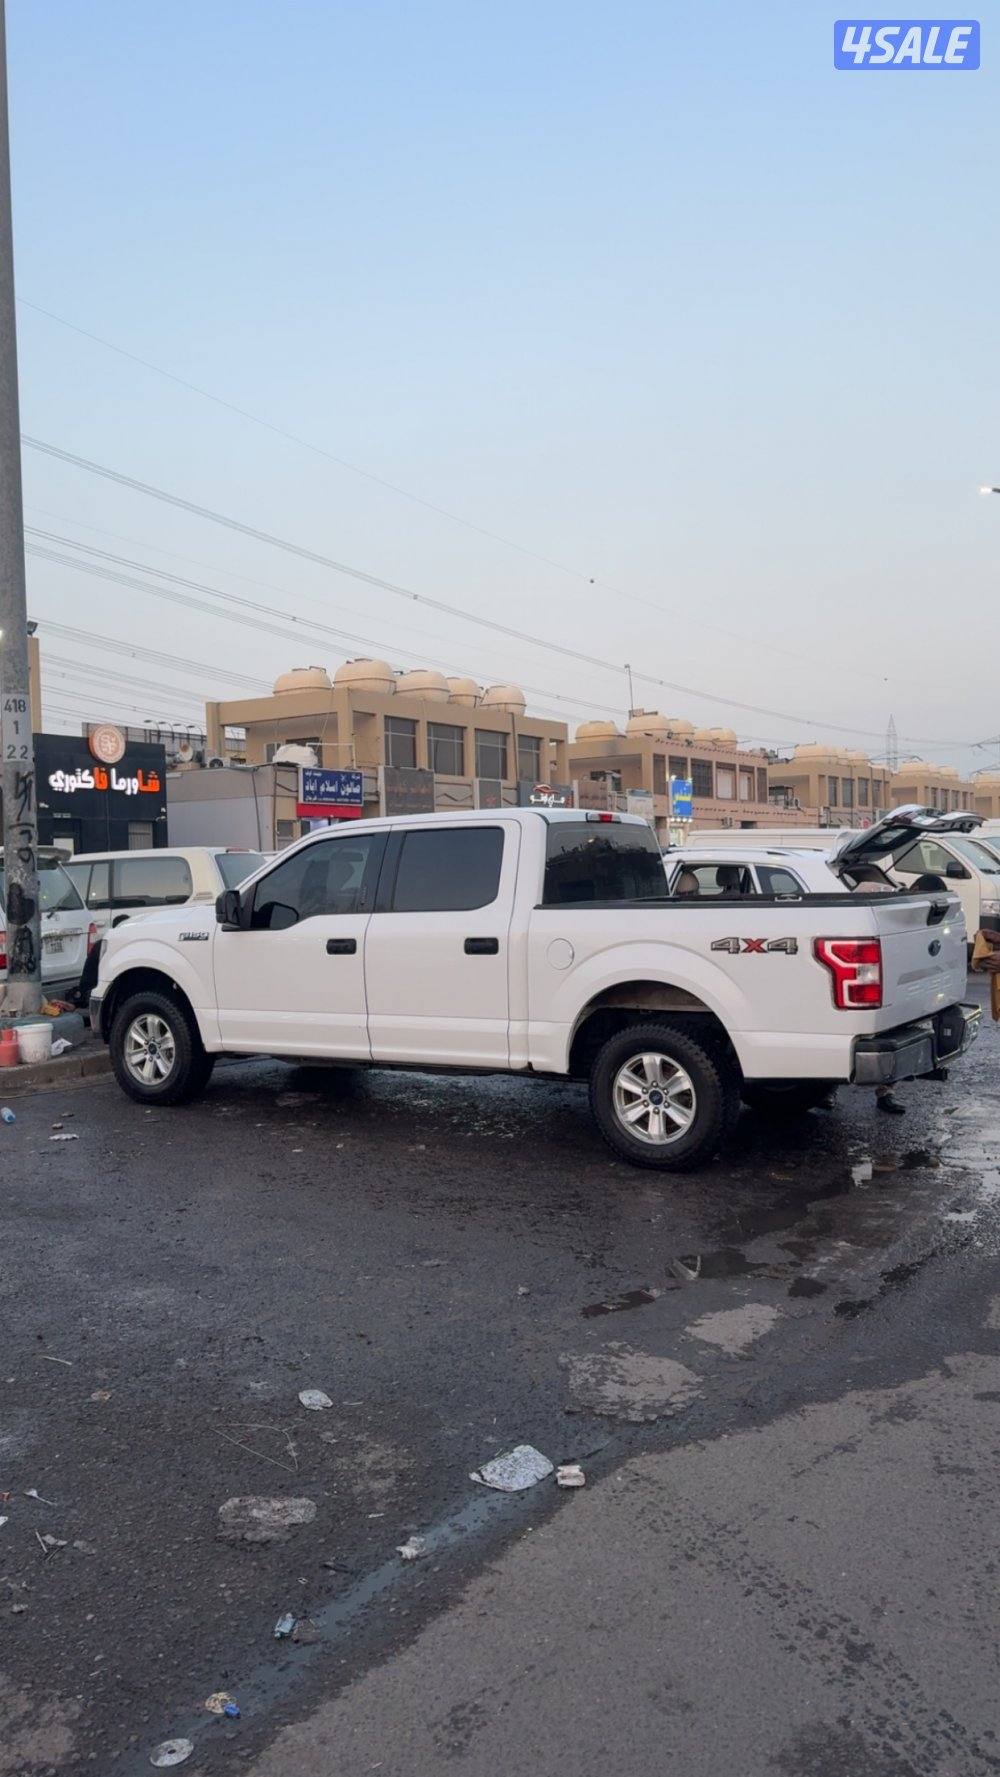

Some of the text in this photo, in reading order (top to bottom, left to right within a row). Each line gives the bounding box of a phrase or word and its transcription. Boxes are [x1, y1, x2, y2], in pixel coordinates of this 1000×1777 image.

[4, 699, 27, 713] 418
[13, 720, 20, 735] 1
[110, 767, 161, 796] شاورما
